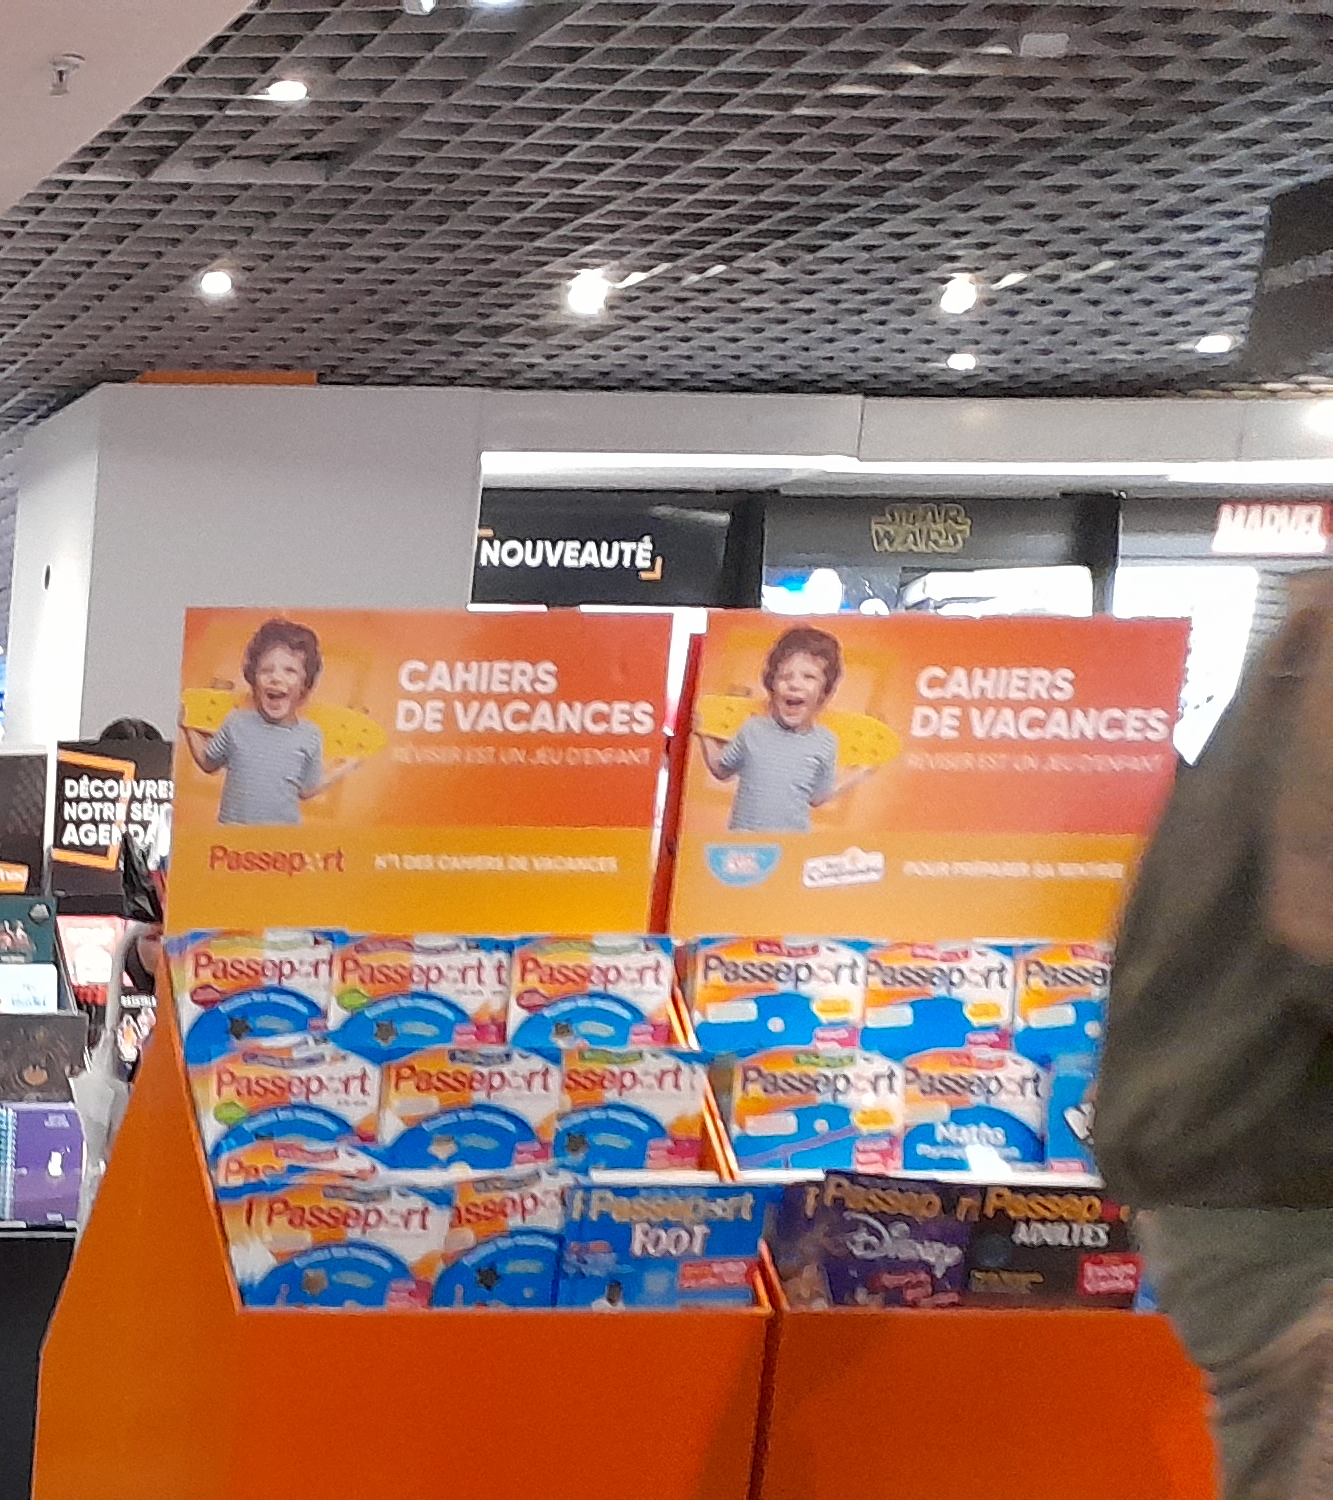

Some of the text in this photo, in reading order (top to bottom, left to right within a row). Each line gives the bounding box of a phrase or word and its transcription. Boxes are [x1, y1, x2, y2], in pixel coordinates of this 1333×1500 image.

[480, 535, 653, 568] NOUVEAUTÉ
[398, 660, 559, 694] CAHIERS
[916, 665, 1075, 701] CAHIERS
[395, 700, 655, 735] DE VACANCES
[910, 704, 1170, 741] DE VACANCES
[64, 802, 122, 821] NOTRE
[1025, 959, 1109, 988] Passe
[565, 1065, 682, 1097] sseprt
